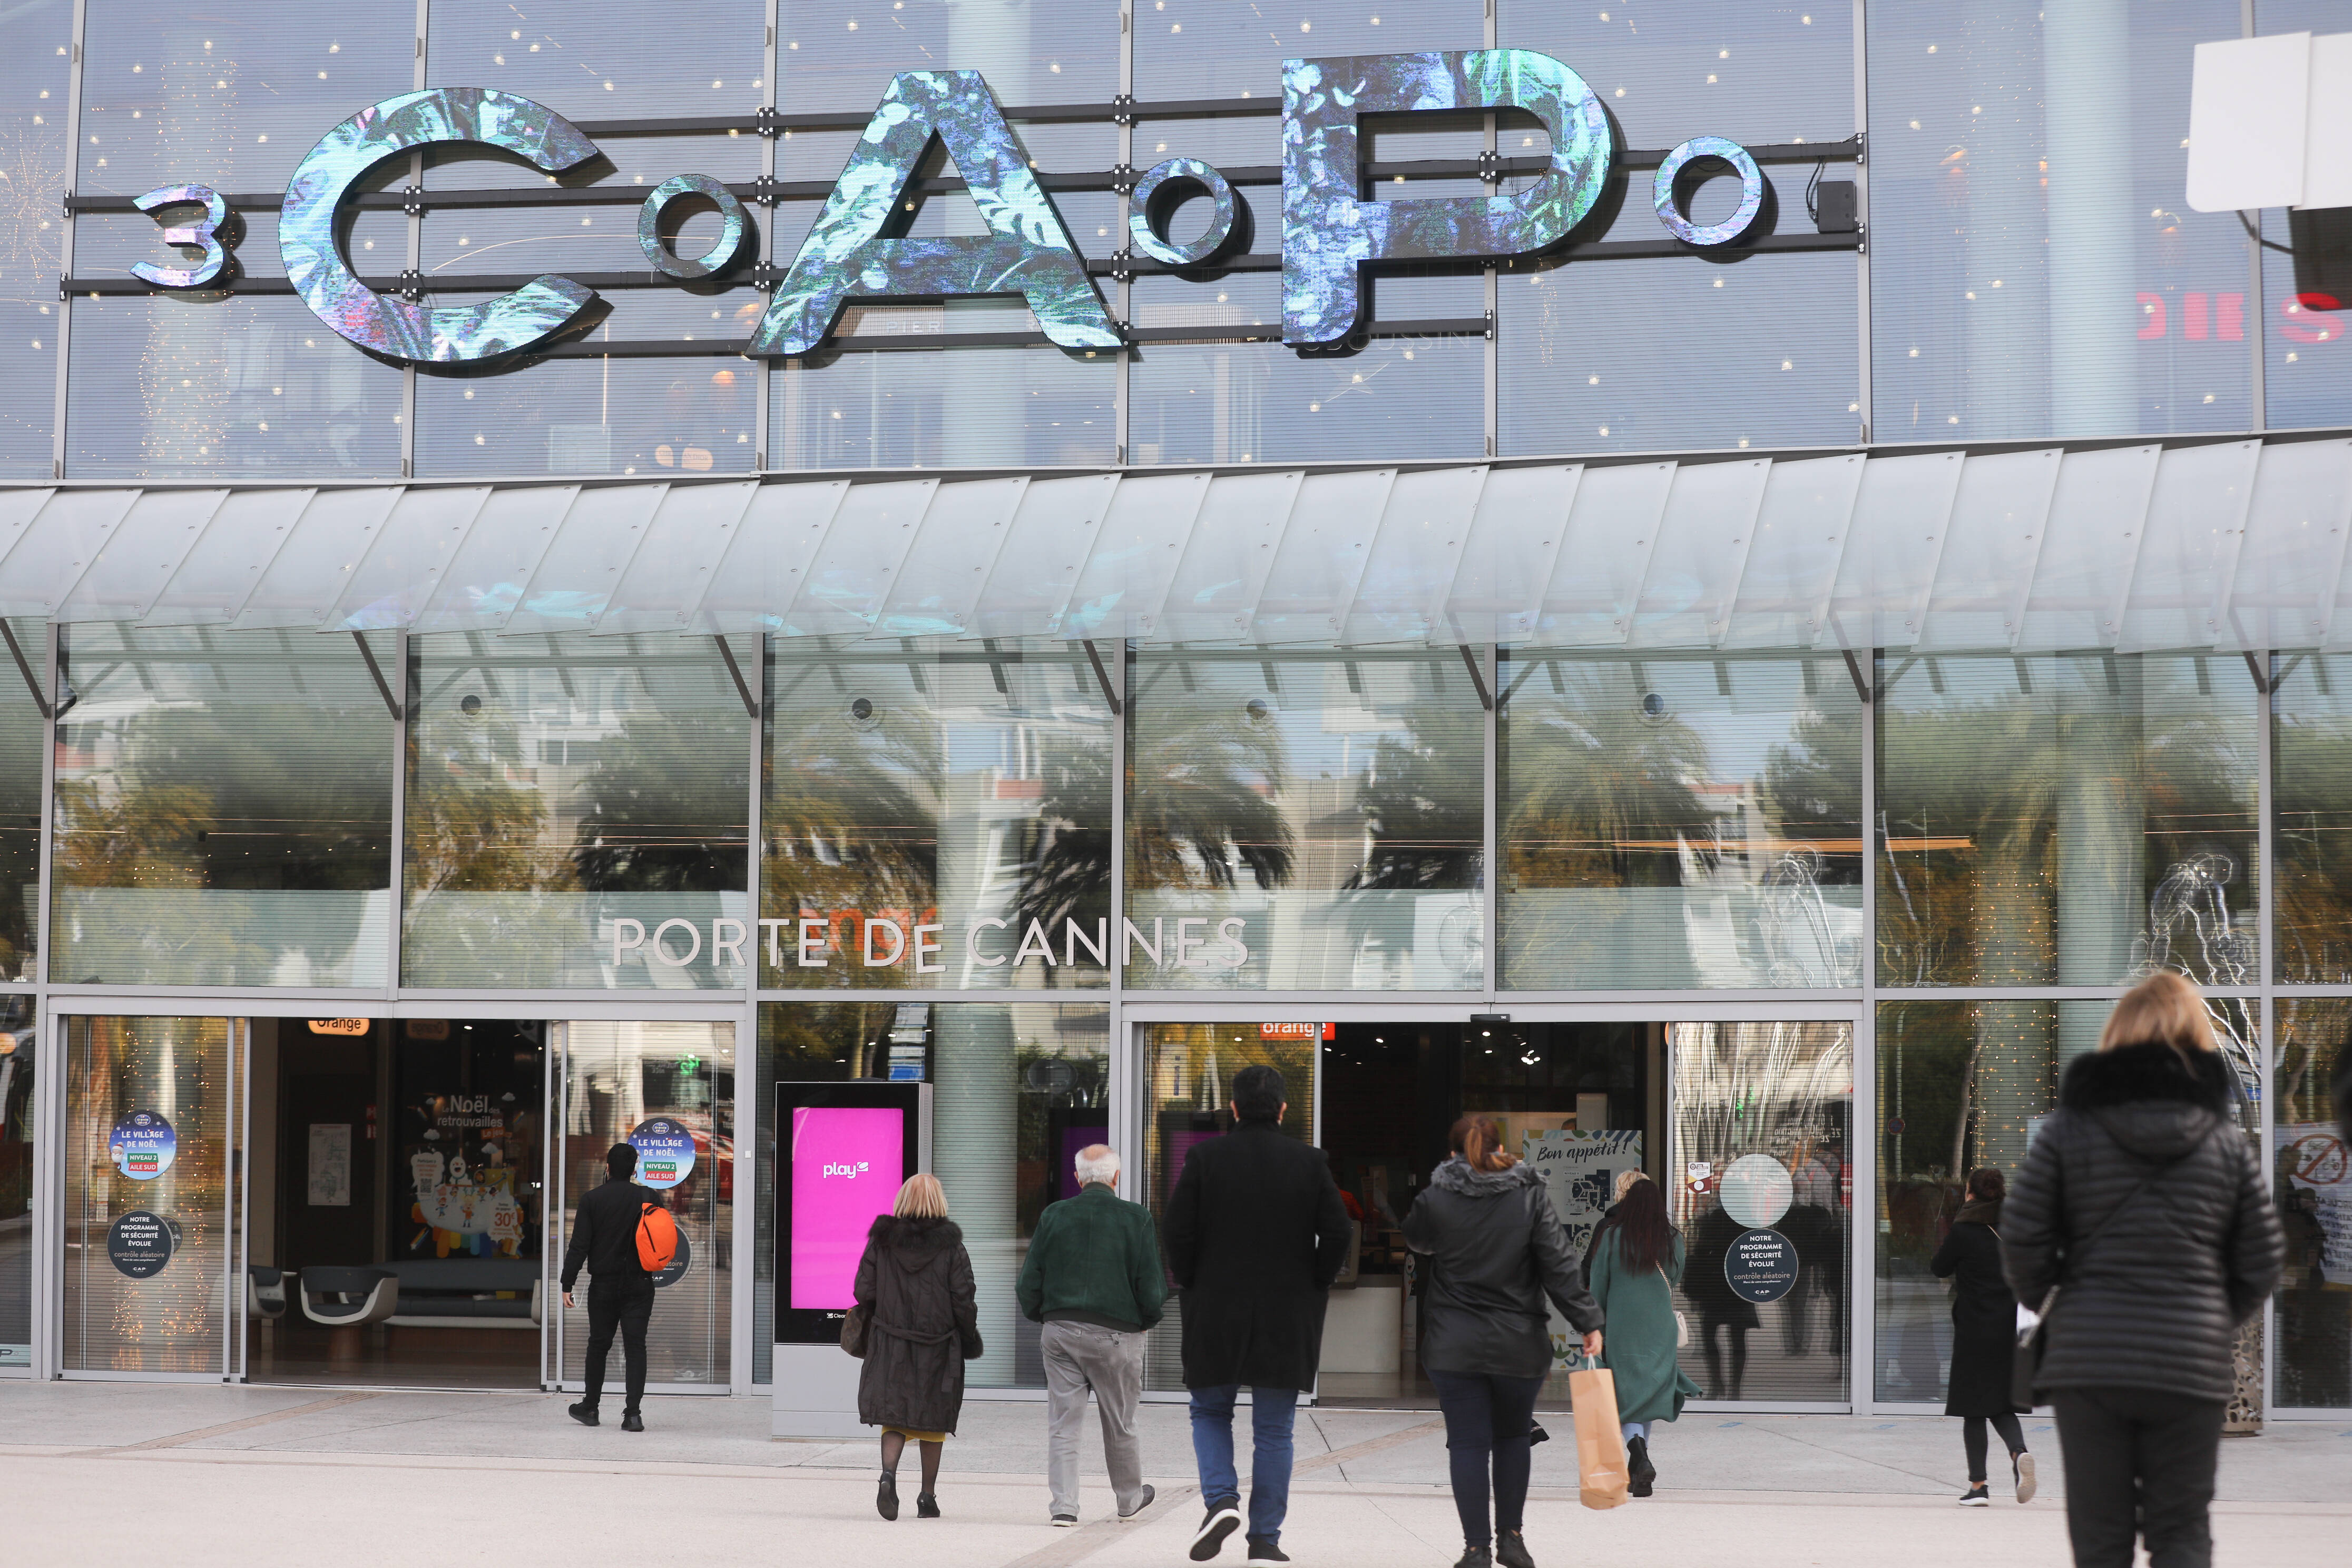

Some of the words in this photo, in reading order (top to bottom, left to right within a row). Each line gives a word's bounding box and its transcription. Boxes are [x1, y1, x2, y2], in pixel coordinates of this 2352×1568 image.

[613, 918, 829, 967] PORTE
[864, 918, 946, 974] DE
[966, 917, 1249, 967] CANNES
[450, 1095, 488, 1113] Noël
[437, 1116, 503, 1128] retrouvailles
[656, 1148, 677, 1157] NOËL
[1537, 1146, 1564, 1162] Bon
[1566, 1141, 1621, 1163] appétit
[823, 1162, 857, 1179] play
